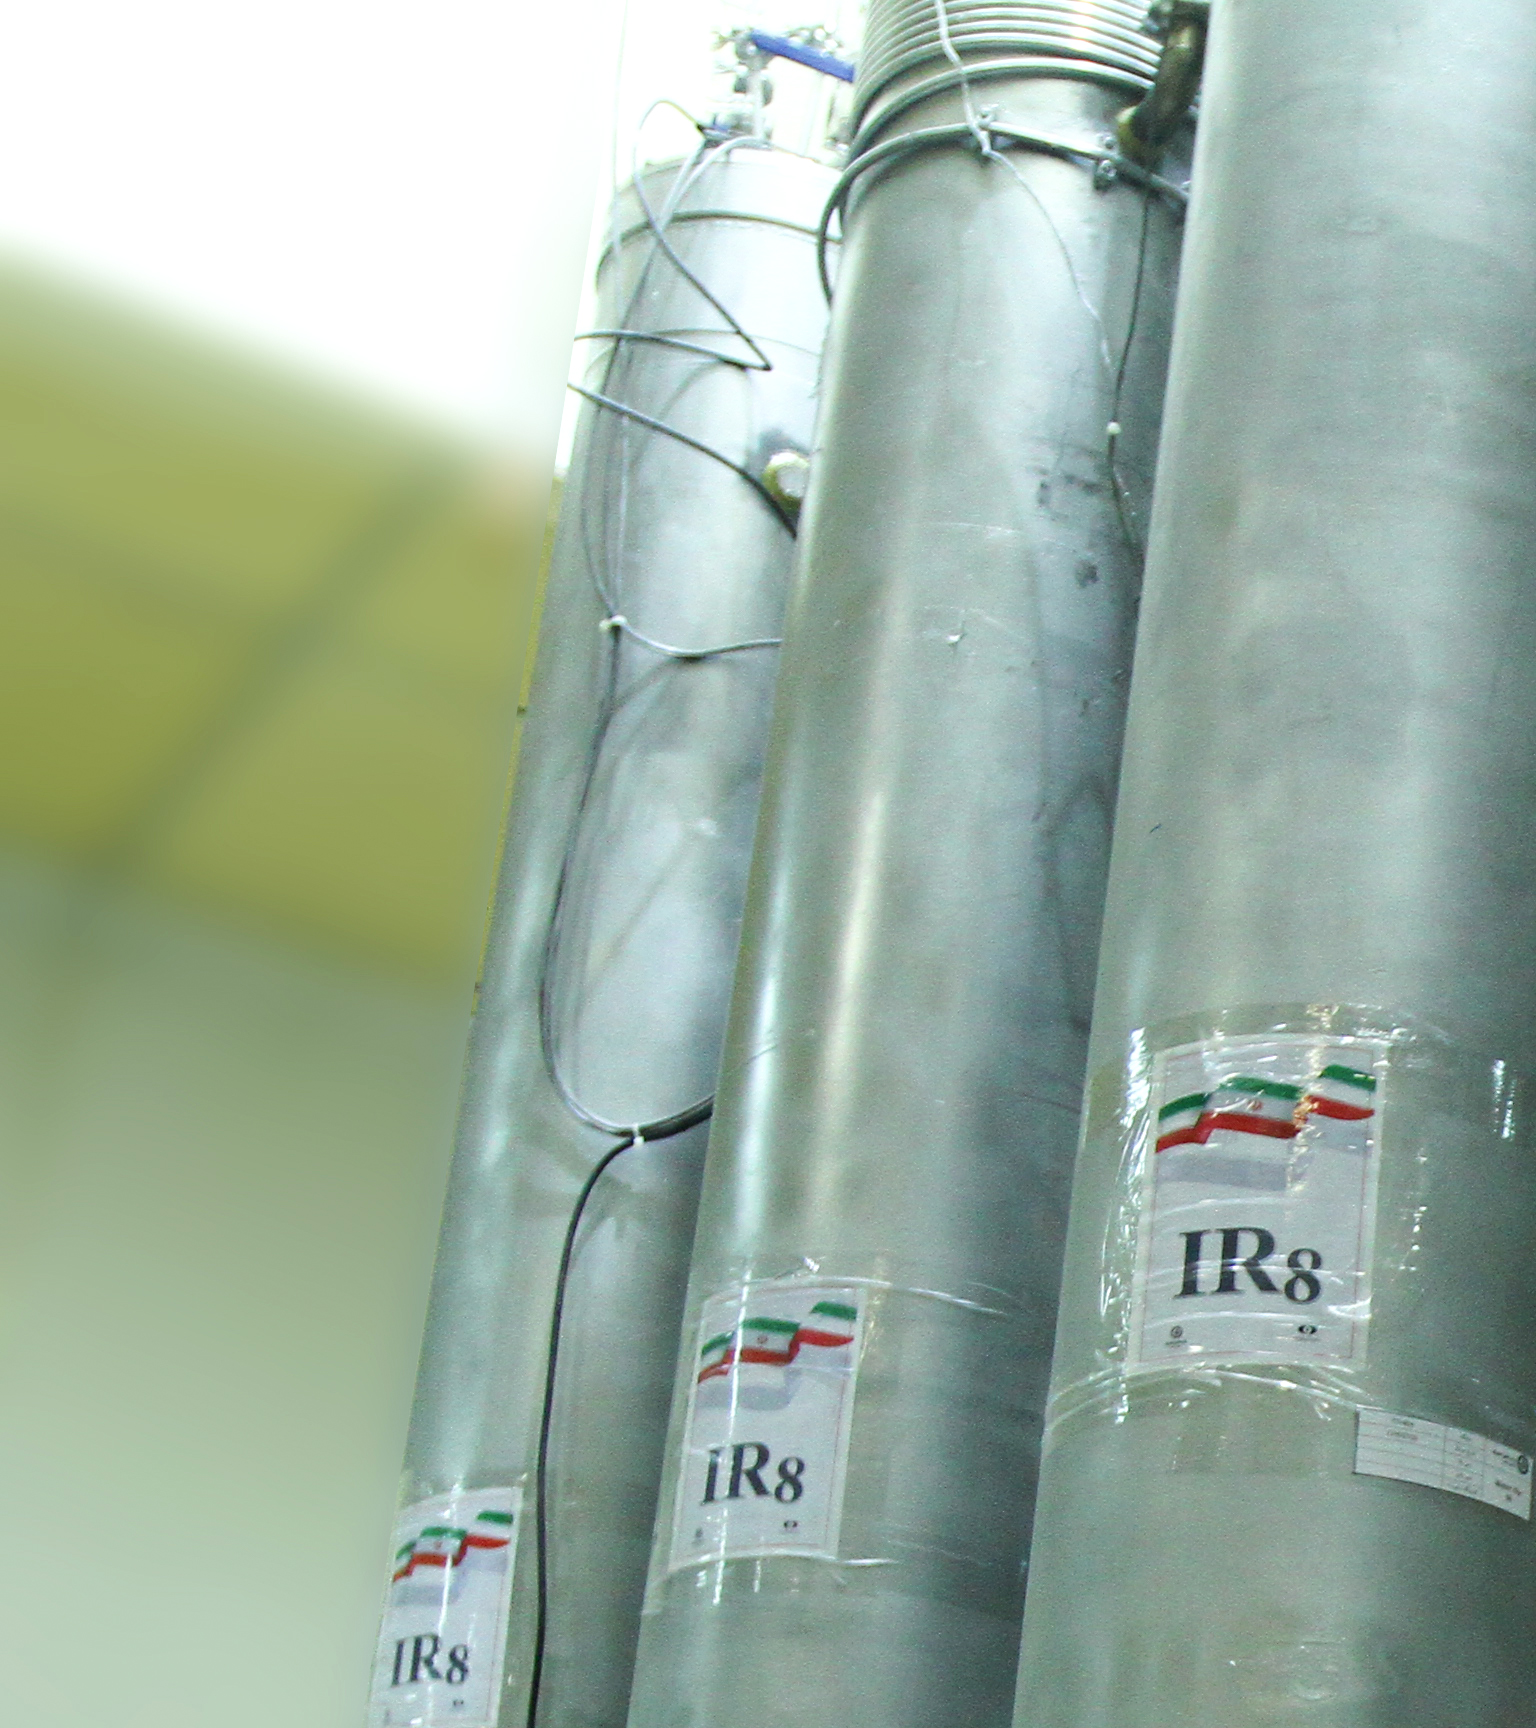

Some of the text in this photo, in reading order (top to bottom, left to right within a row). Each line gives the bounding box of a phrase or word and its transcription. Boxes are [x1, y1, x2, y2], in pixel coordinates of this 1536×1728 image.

[1173, 1226, 1323, 1304] IR8
[700, 1440, 806, 1506] IR8
[390, 1633, 470, 1689] IR8
